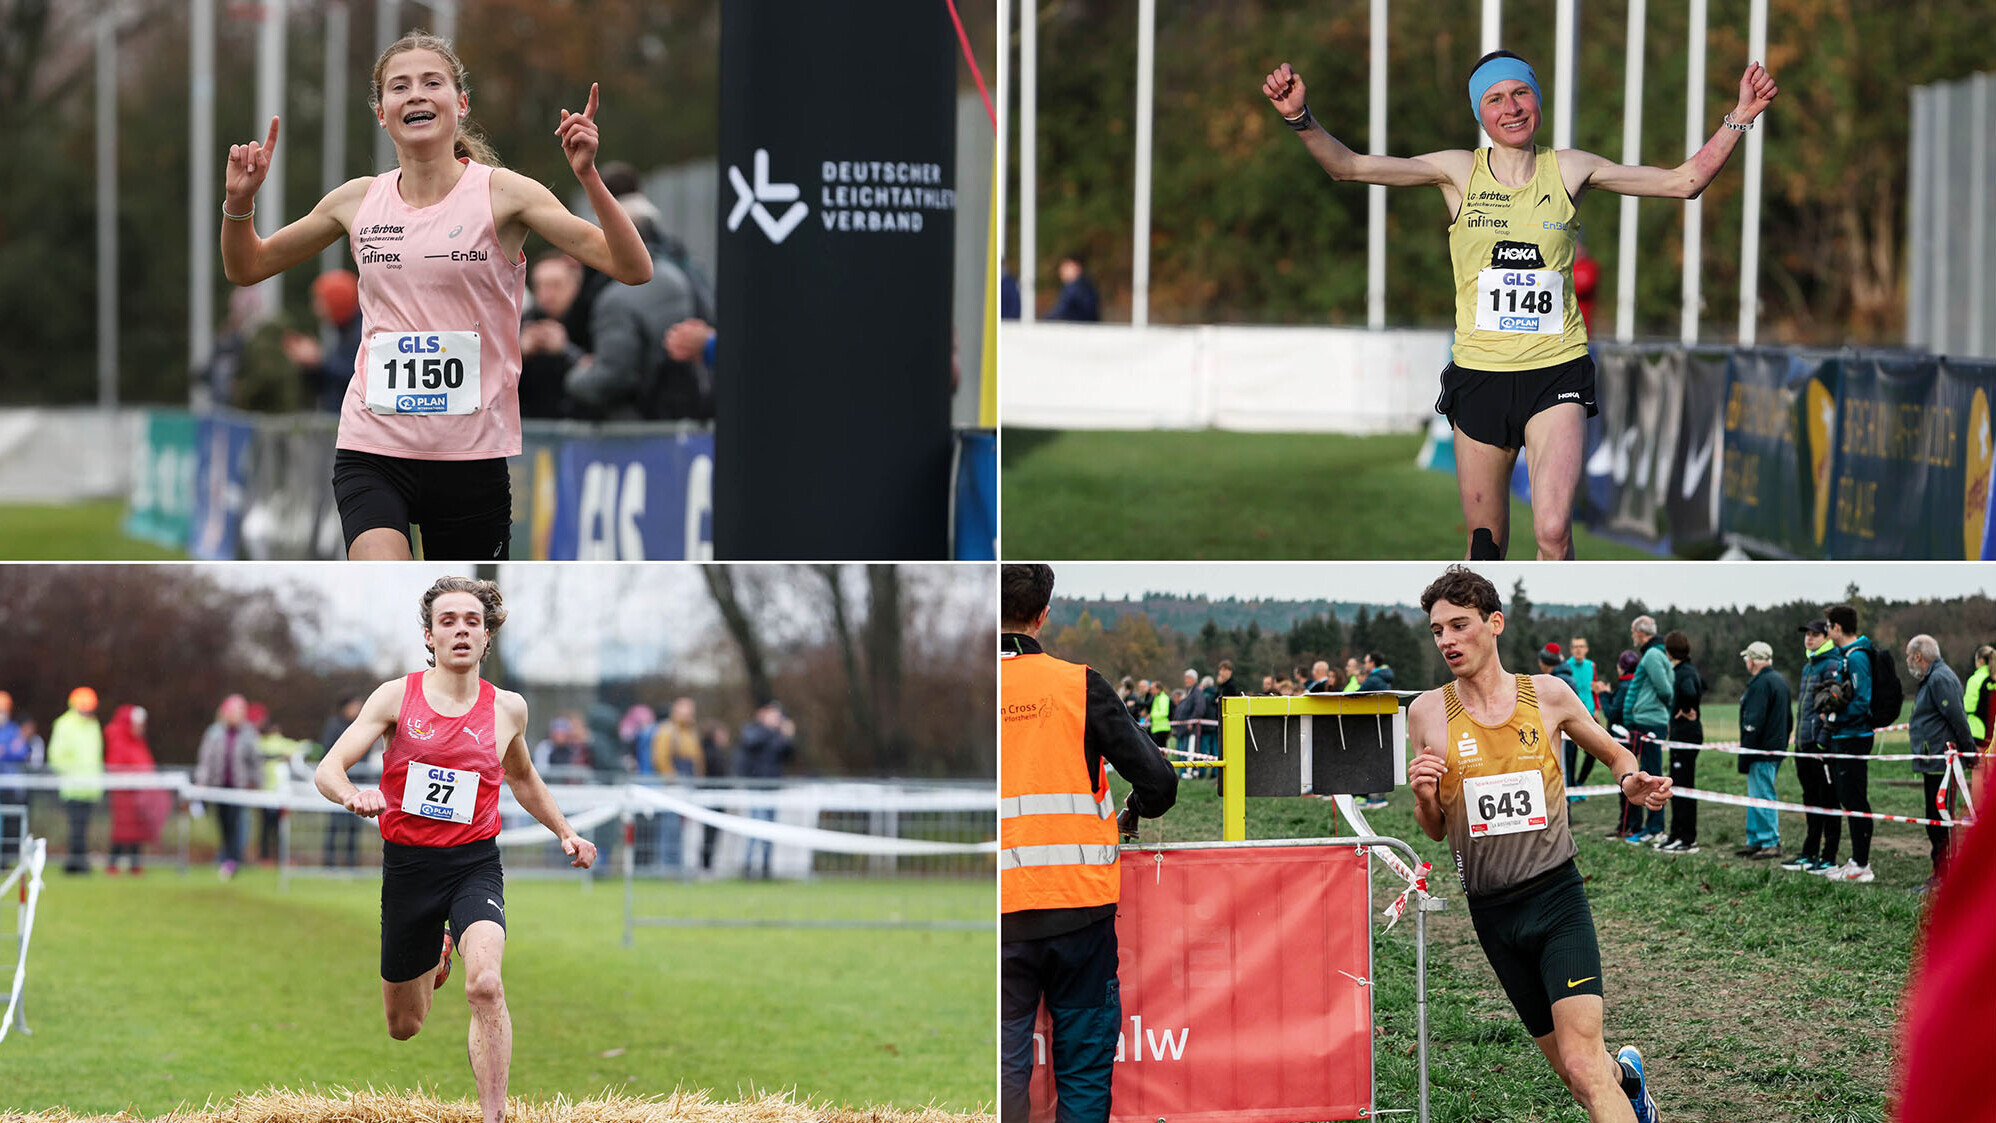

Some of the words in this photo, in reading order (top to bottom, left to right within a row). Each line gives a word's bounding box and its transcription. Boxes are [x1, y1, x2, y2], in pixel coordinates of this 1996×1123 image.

[822, 161, 942, 183] DEUTSCHER
[821, 211, 923, 232] VERBAND
[1467, 215, 1509, 228] infinex
[362, 250, 401, 264] infinex
[451, 251, 488, 262] EnBW
[1497, 247, 1537, 261] HOKA
[1490, 288, 1552, 314] 1148
[1515, 319, 1538, 327] PLAN
[384, 358, 463, 388] 1150
[417, 397, 446, 406] PLAN
[1557, 391, 1580, 400] HOKA
[1008, 703, 1037, 714] Cross
[426, 782, 455, 804] 27
[433, 808, 452, 816] PLAN
[1478, 790, 1532, 821] 643
